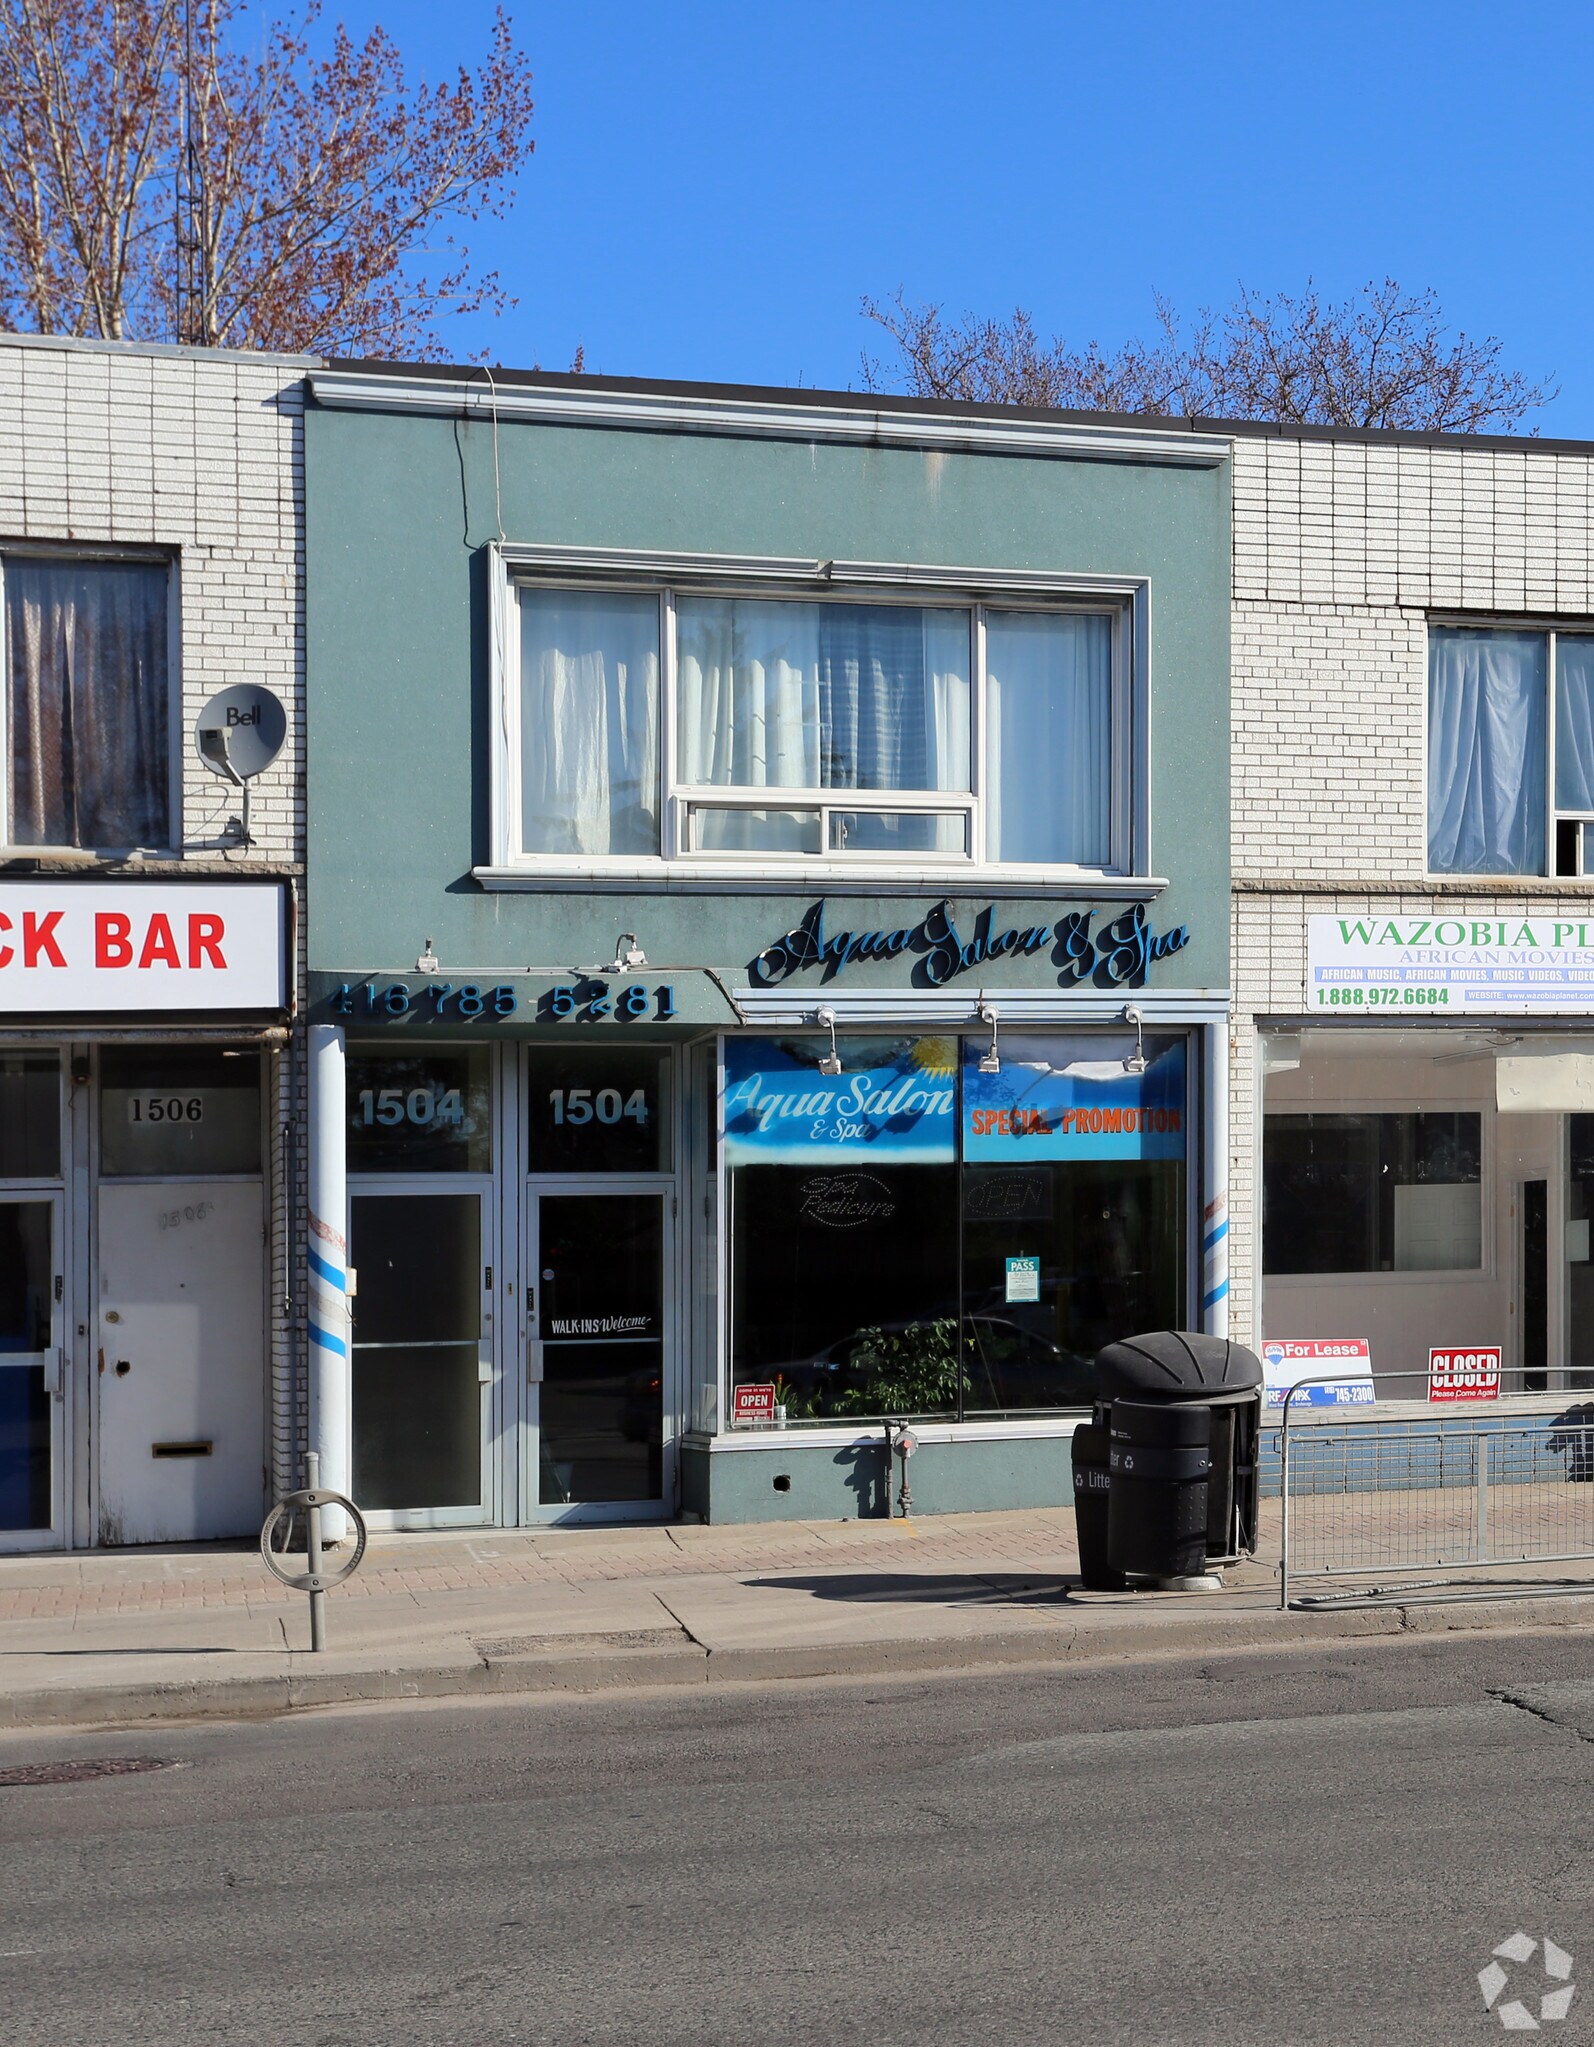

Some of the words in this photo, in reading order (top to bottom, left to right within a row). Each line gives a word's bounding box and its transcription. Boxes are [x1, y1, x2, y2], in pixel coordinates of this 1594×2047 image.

[226, 705, 261, 727] Bell
[95, 912, 228, 969] BAR
[757, 898, 916, 983] Aqua
[924, 899, 1050, 985] Salon
[1066, 909, 1099, 979] &
[1108, 902, 1188, 986] Spa
[1336, 920, 1540, 948] WAZOBIA
[1399, 949, 1500, 964] AFRICAN
[1508, 951, 1594, 965] MOVIES
[1321, 969, 1363, 981] AFRICAN
[1366, 969, 1402, 981] MUSIC,
[1405, 970, 1447, 981] AFRICAN
[1450, 970, 1490, 982] MOVIES,
[1492, 970, 1525, 981] MUSIC
[1528, 971, 1565, 982] VIDEOS,
[331, 983, 409, 1015] 416
[428, 984, 518, 1015] 785
[552, 984, 679, 1015] 5281
[1316, 988, 1449, 1005] 1.888.972.6684
[1468, 991, 1504, 999] WEBSITE:
[133, 1099, 202, 1121] 1506
[359, 1089, 465, 1125] 1504
[550, 1089, 648, 1125] 1504
[725, 1073, 831, 1133] Aqua
[837, 1075, 954, 1117] Salon
[809, 1119, 829, 1140] &
[829, 1117, 871, 1143] Spa
[971, 1107, 1053, 1135] SPECIAL
[1063, 1106, 1181, 1134] PROMOTION
[800, 1194, 895, 1216] Pedicure
[967, 1183, 1043, 1209] OPEN
[1011, 1261, 1034, 1271] PASS
[599, 1315, 651, 1333] Welcome
[1285, 1343, 1310, 1356] For
[1314, 1343, 1359, 1356] Lease
[1432, 1354, 1498, 1388] CLOSED
[741, 1394, 768, 1407] OPEN
[1335, 1386, 1373, 1403] 745-2300
[1431, 1390, 1454, 1398] Please
[1455, 1389, 1476, 1397] Come
[1477, 1389, 1496, 1397] Again
[1089, 1471, 1110, 1488] Litte
